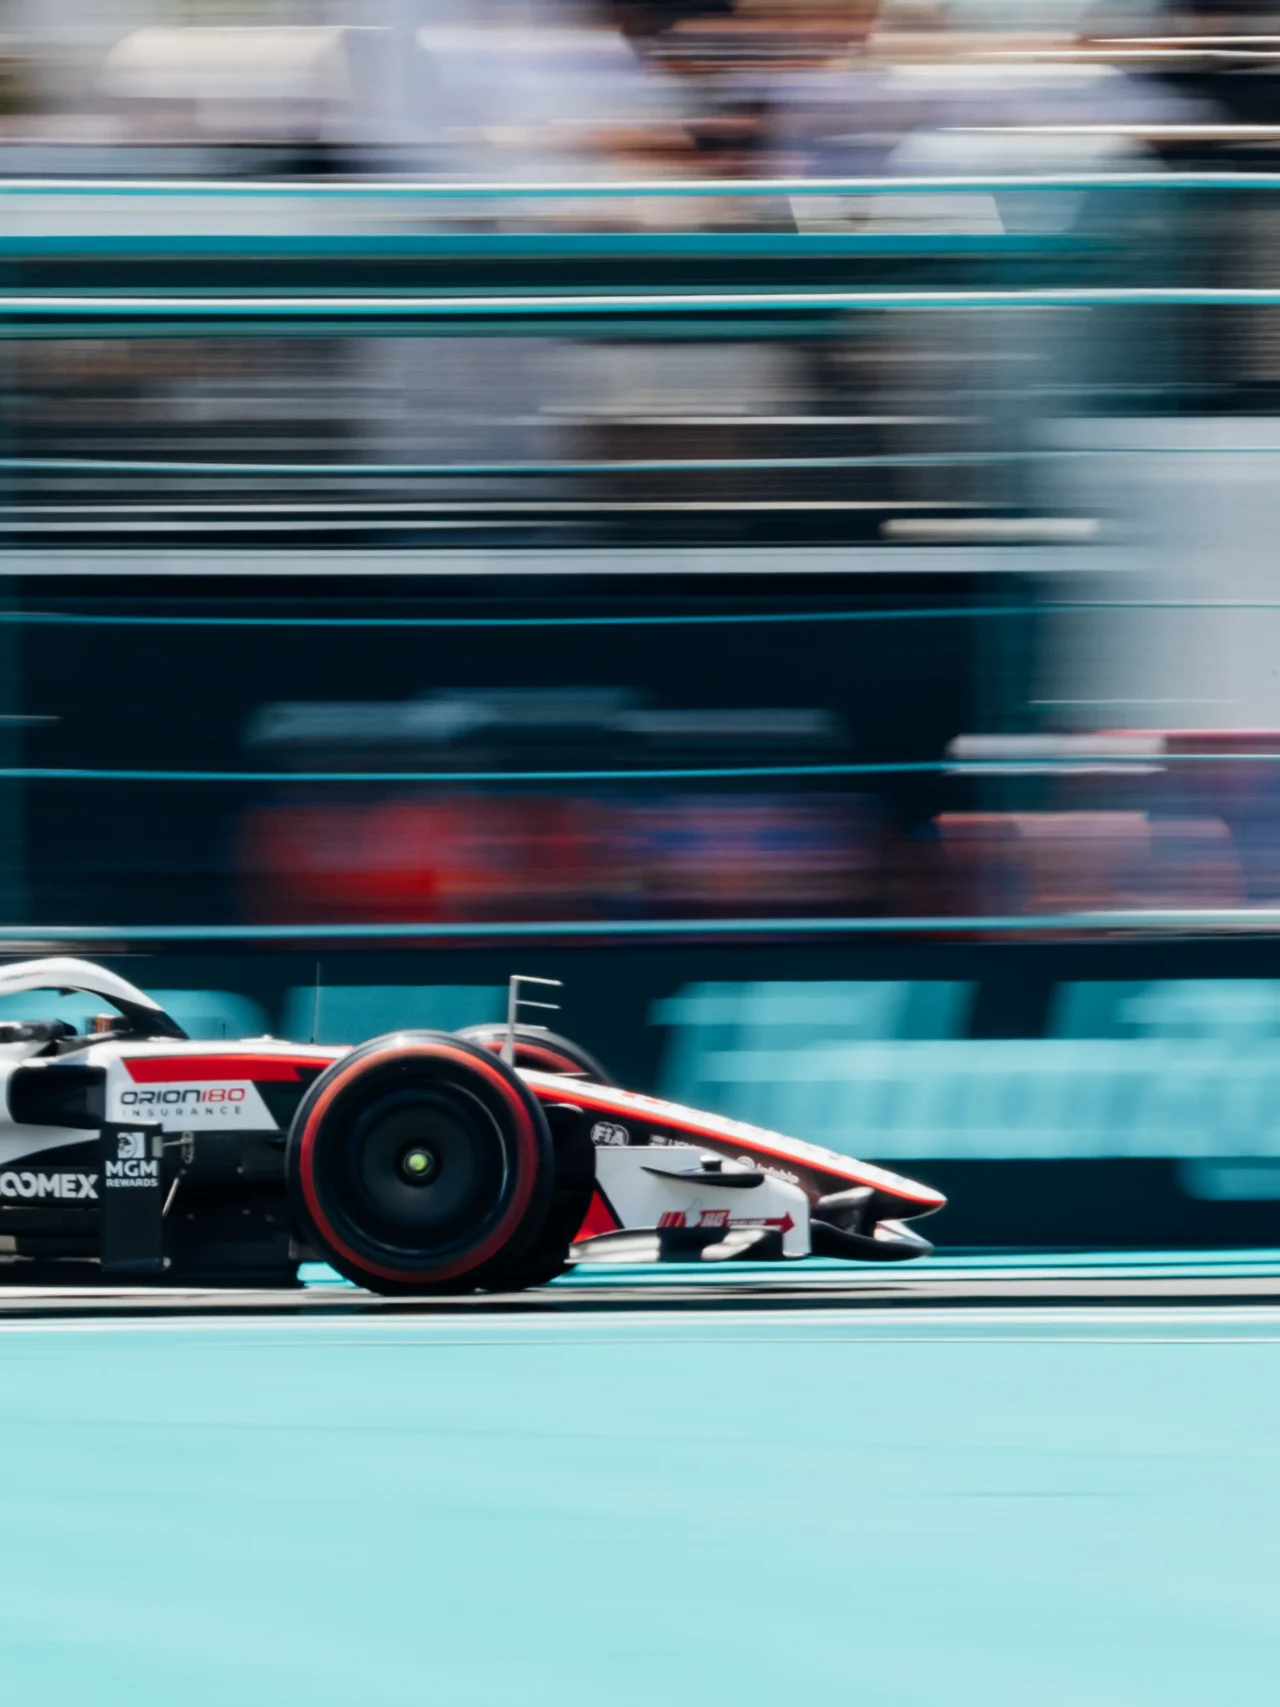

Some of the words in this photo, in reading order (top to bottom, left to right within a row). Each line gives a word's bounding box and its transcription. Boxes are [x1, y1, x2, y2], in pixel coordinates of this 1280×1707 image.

[120, 1088, 246, 1105] ORION180
[122, 1105, 243, 1118] INSURANCE
[106, 1160, 159, 1178] MGM
[106, 1178, 160, 1188] REWARDS
